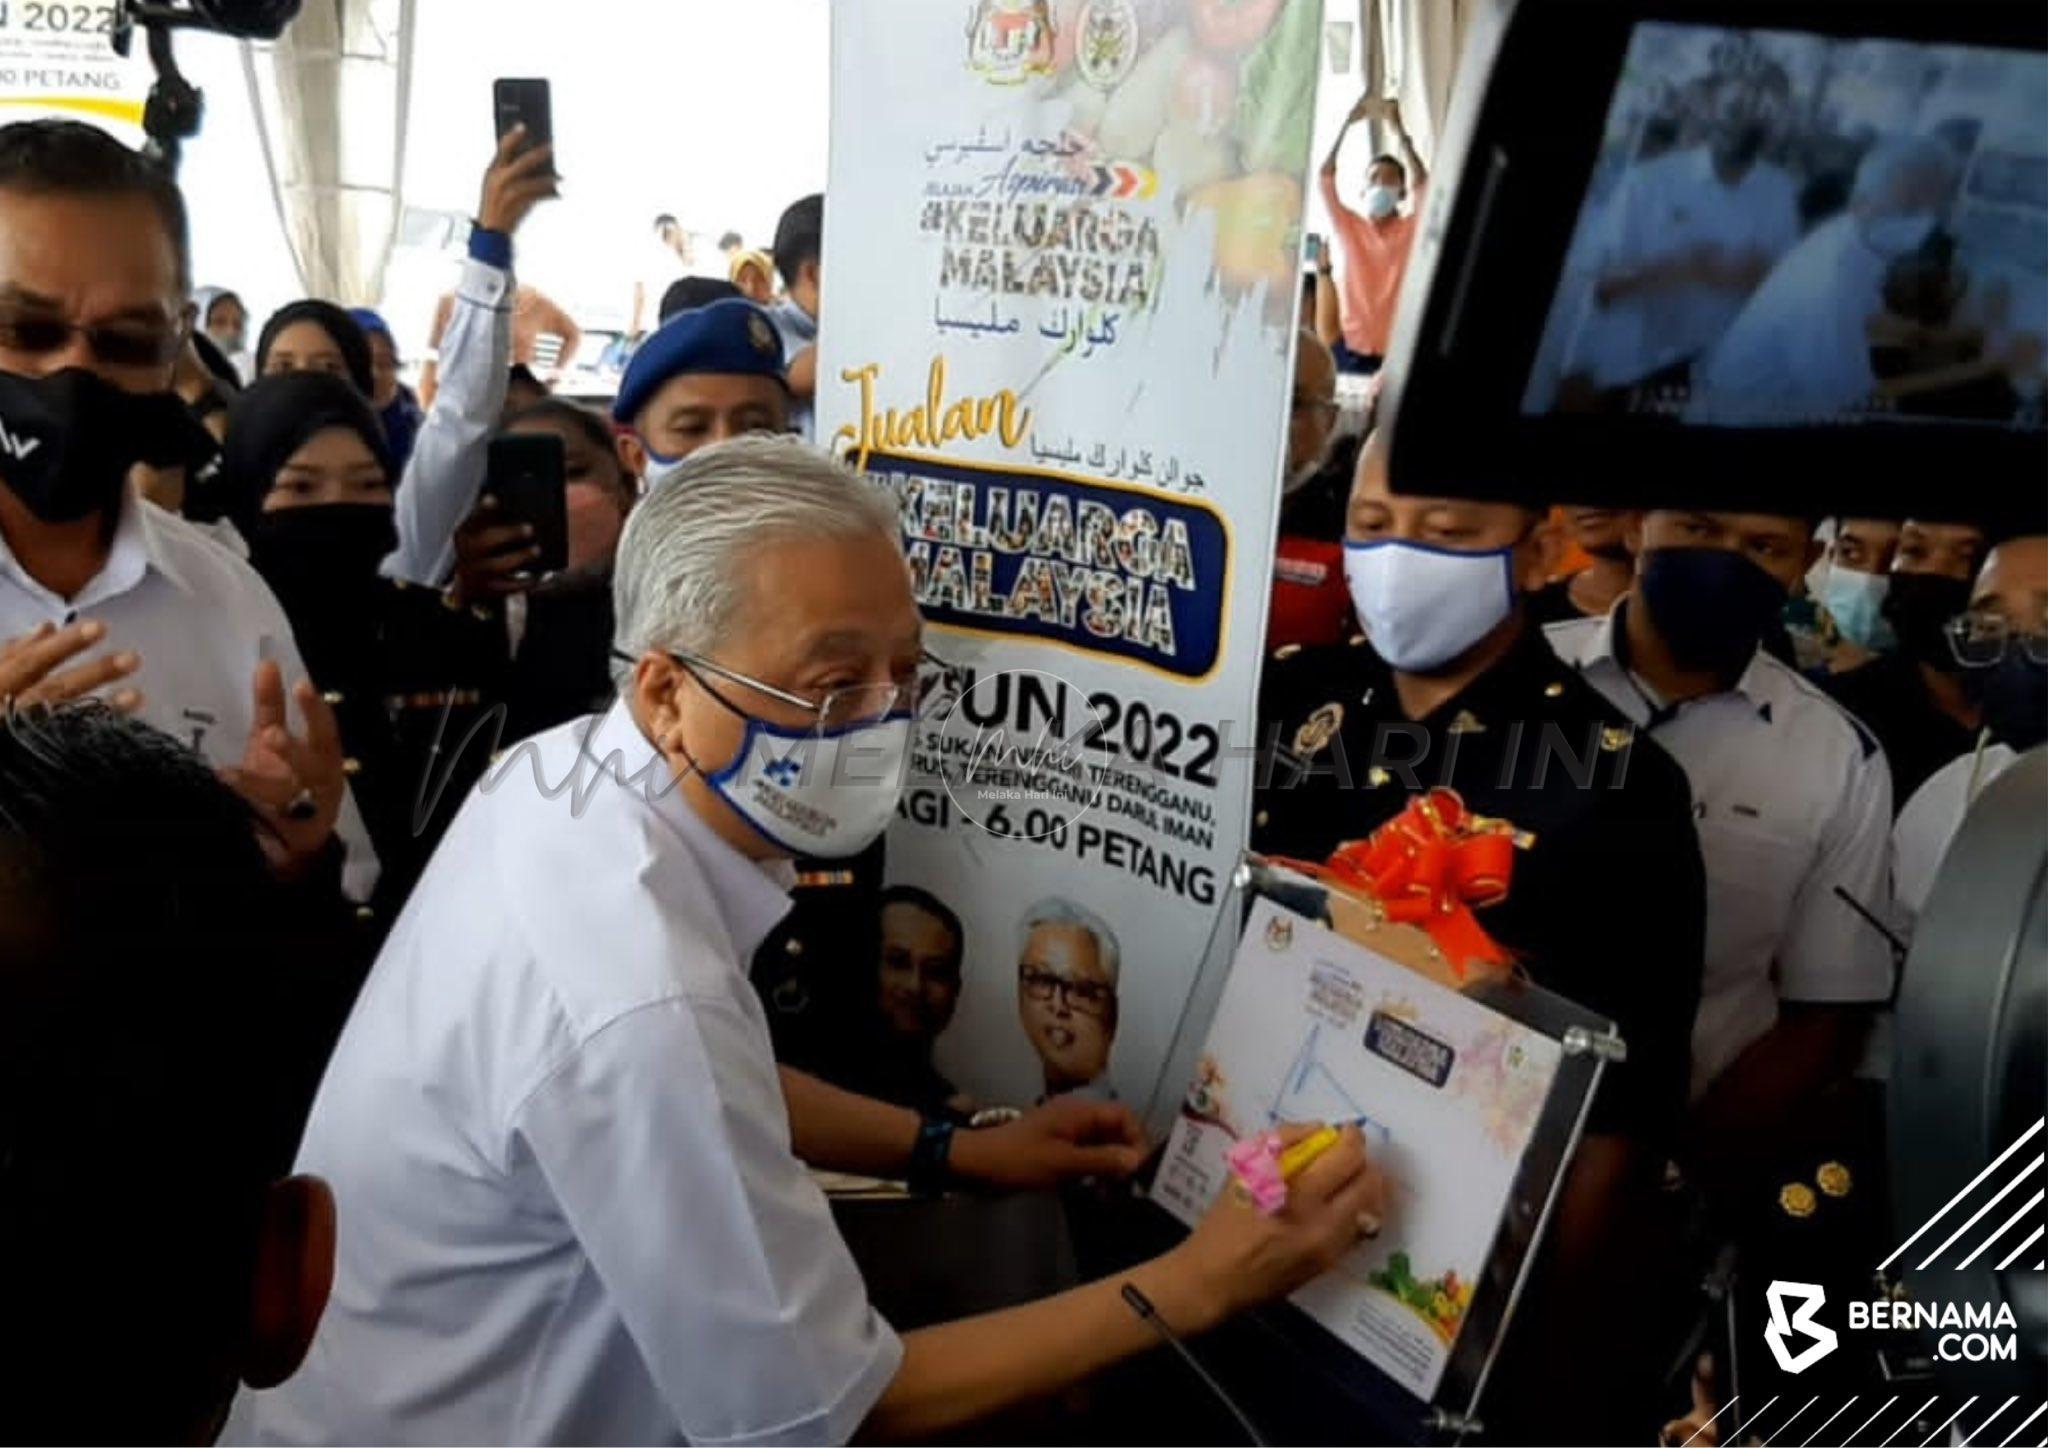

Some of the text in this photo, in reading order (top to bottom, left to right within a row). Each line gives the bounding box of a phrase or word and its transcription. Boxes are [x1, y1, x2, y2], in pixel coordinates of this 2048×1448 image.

[24, 2, 116, 35] 2022
[25, 70, 121, 90] PETANG
[940, 247, 1150, 306] MALAYSIA
[830, 353, 1032, 474] Jualan
[1086, 691, 1220, 789] 2022
[985, 803, 1068, 851] 6.00
[1077, 822, 1216, 906] PETANG
[1162, 816, 1213, 850] IMAN
